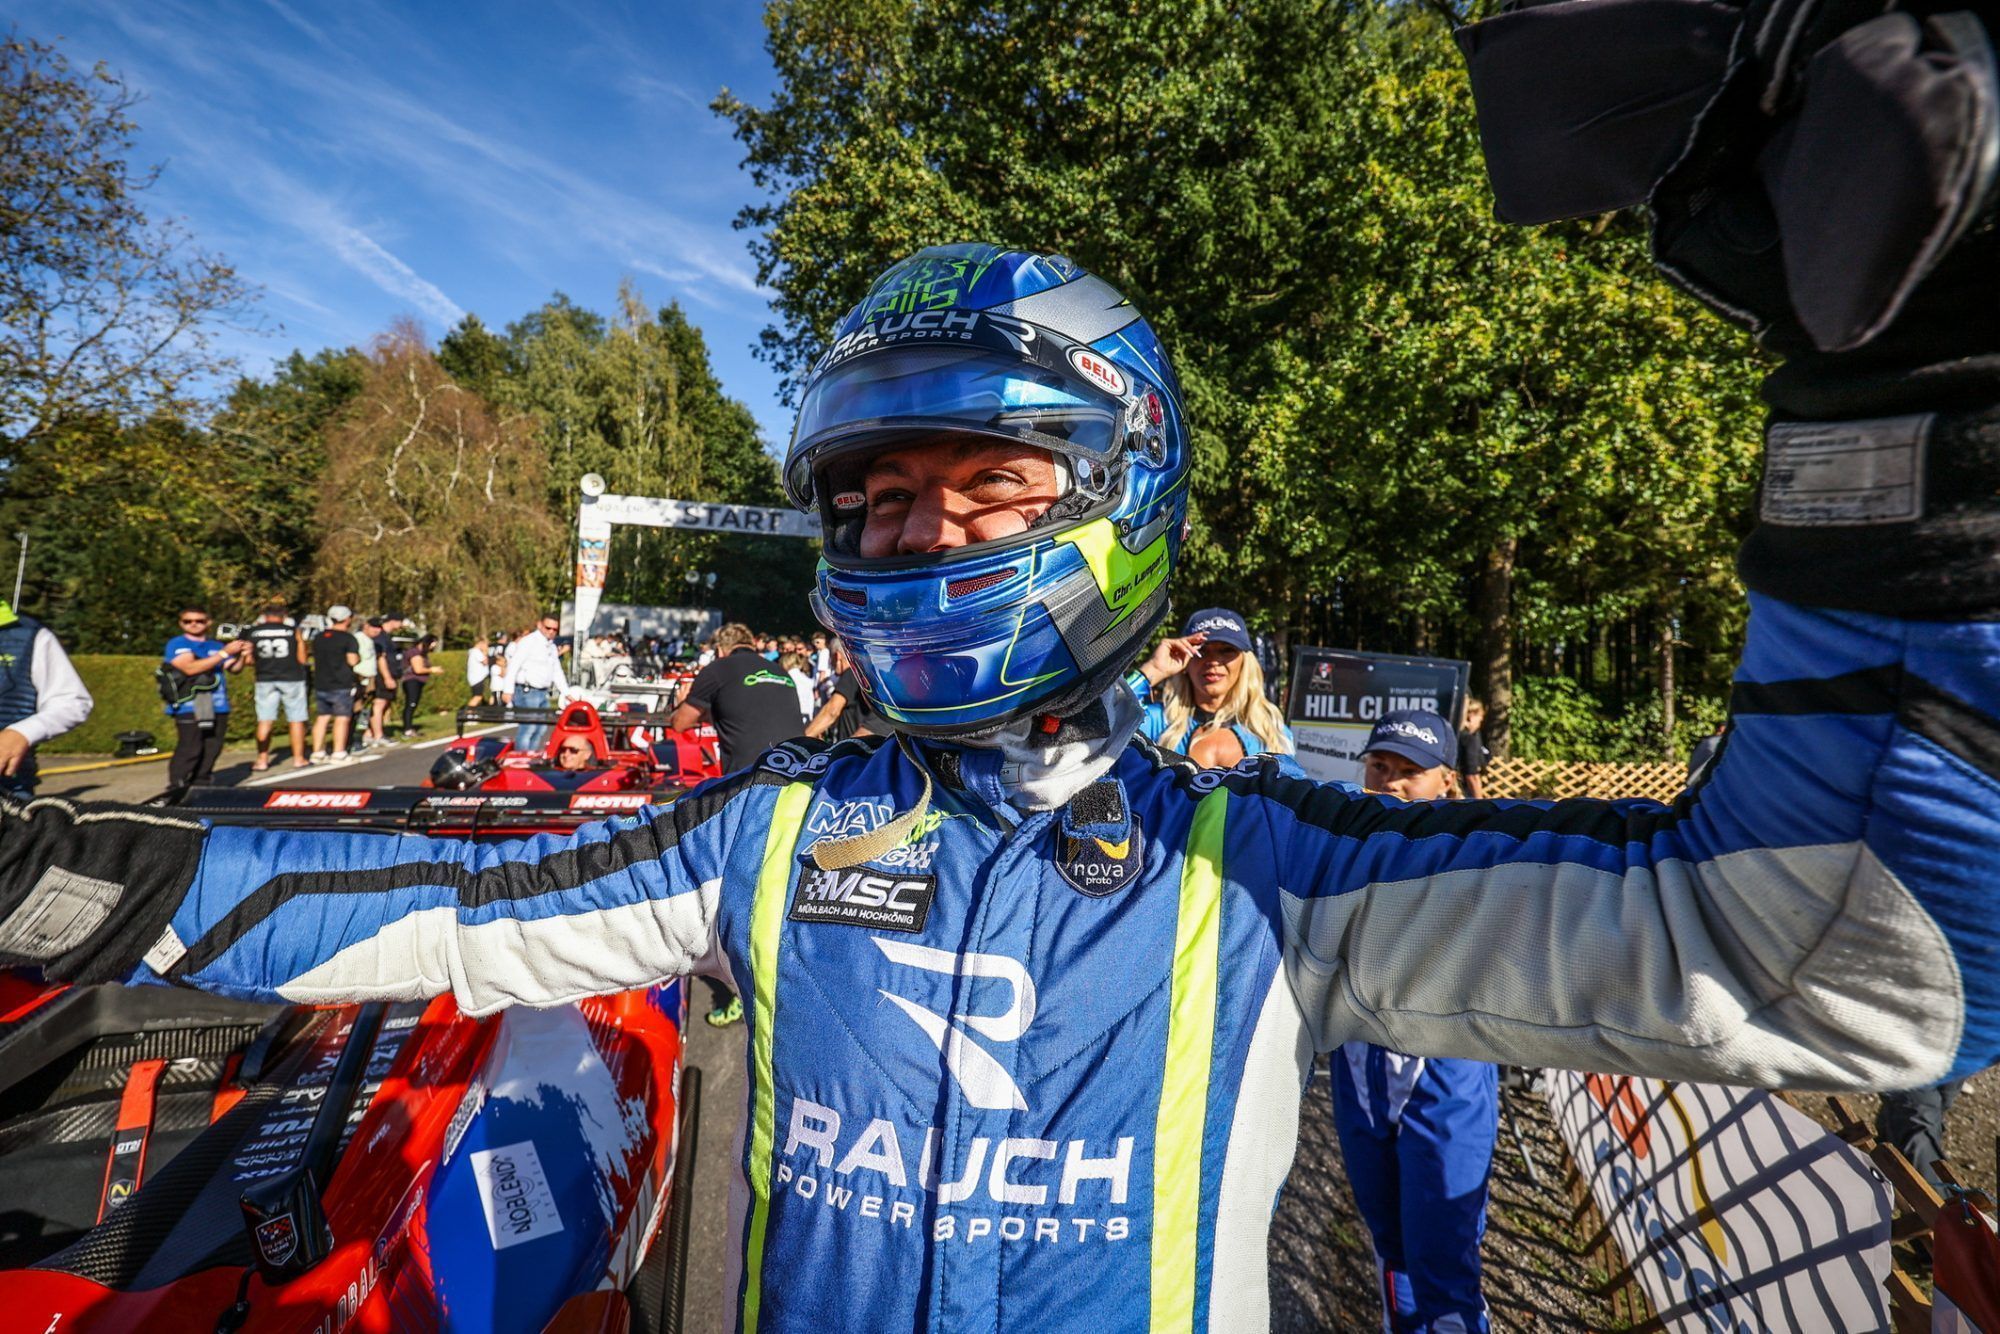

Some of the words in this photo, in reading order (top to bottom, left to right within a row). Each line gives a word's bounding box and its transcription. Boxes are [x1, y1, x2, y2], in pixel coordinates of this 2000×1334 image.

[829, 310, 980, 360] RAUCH
[885, 330, 973, 343] SPORTS
[1081, 355, 1118, 388] BELL
[837, 494, 864, 506] BELL
[682, 505, 785, 532] START
[1113, 582, 1133, 604] Chr.
[256, 638, 289, 659] 33
[1304, 694, 1354, 718] HILL
[1297, 728, 1349, 747] Esthofen
[1296, 741, 1347, 759] Information
[1192, 758, 1259, 789] OP
[270, 793, 362, 808] MOTUL
[573, 796, 647, 809] MOTUL
[1074, 863, 1124, 878] nova
[1085, 876, 1113, 886] proto
[816, 870, 928, 912] MSC
[798, 903, 840, 916] MÜHLBACH
[842, 907, 858, 918] AM
[858, 909, 914, 926] HOCHKÖNIG
[783, 1097, 1135, 1205] RAUCH
[776, 1162, 915, 1230] POWER
[932, 1214, 1130, 1245] SPORTS
